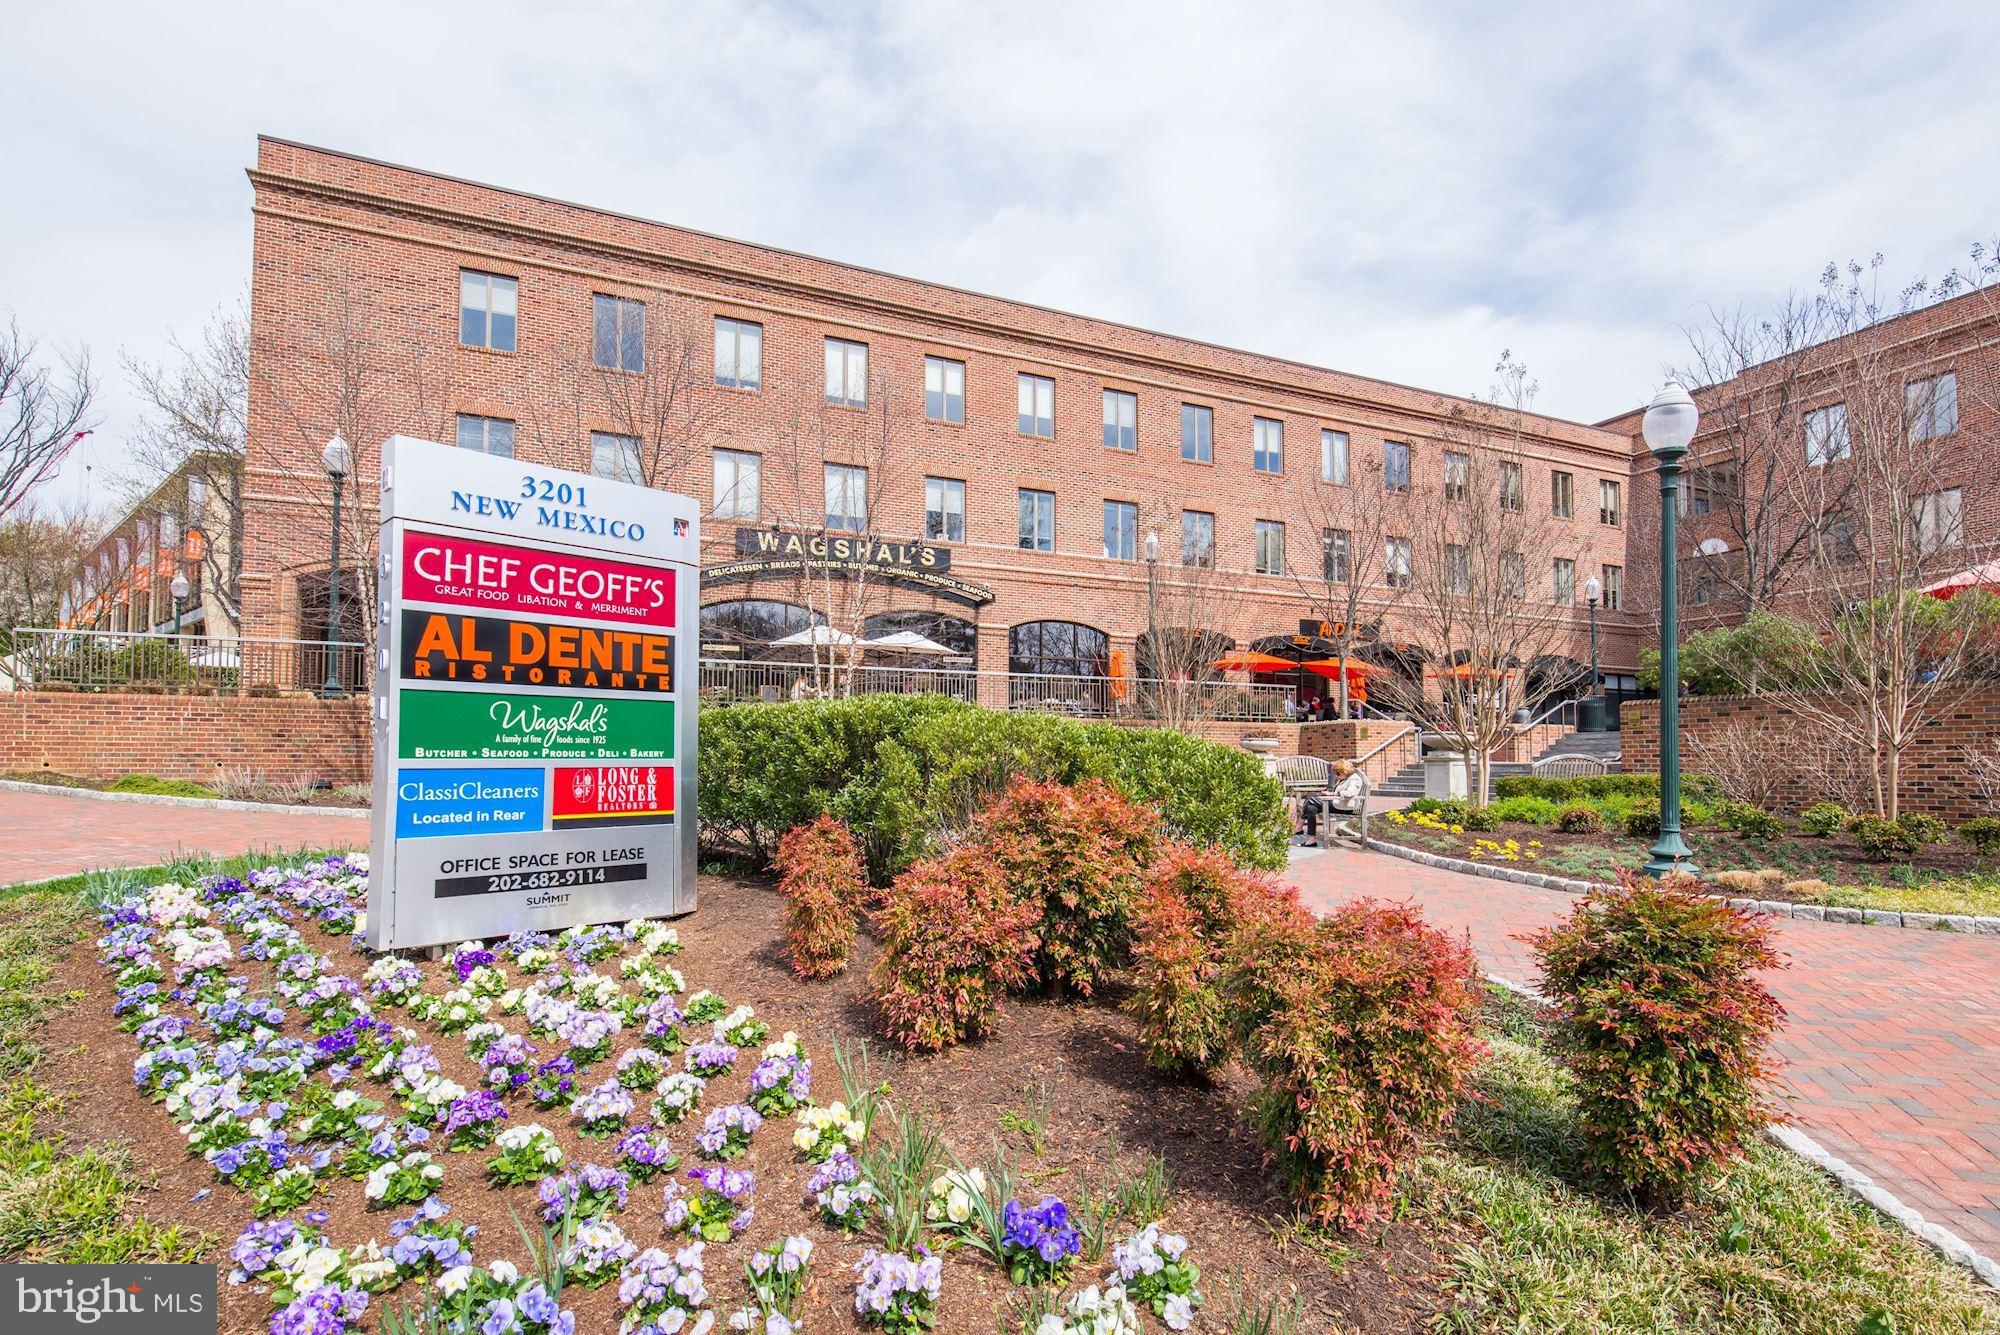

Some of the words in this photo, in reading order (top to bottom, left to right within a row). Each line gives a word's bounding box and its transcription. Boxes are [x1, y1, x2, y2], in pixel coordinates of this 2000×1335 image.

[521, 475, 587, 507] 3201
[452, 490, 522, 521] NEW
[537, 506, 645, 542] MEXICO
[757, 531, 936, 566] WAGSHAL'S
[413, 547, 521, 588] CHEF
[530, 563, 665, 608] GEOFF'S
[708, 563, 763, 577] DELICATESSEN
[770, 560, 801, 569] BREADS
[807, 560, 842, 568] PASTRIES
[886, 567, 919, 578] ORGANIC
[924, 574, 956, 588] PRODUCE
[961, 583, 993, 600] SEAFOOD
[435, 584, 474, 597] GREAT
[477, 588, 510, 601] FOOD
[517, 593, 567, 608] LIBATION
[575, 601, 583, 610] &
[591, 602, 648, 617] MERRIMENT
[415, 615, 492, 662] AL
[510, 622, 670, 675] DENTE
[415, 659, 670, 690] RISTORANTE
[490, 700, 608, 748] Wagshal's
[415, 747, 468, 758] BUTCHER
[481, 748, 529, 758] SEAFOOD
[541, 748, 586, 758] PRODUCE
[598, 748, 619, 758] DELI
[630, 748, 664, 758] BAKERY
[495, 735, 501, 743] A
[502, 734, 521, 745] family
[522, 734, 530, 743] of
[530, 734, 542, 743] fine
[556, 735, 573, 743] foods
[575, 735, 590, 743] since
[592, 735, 606, 744] 1925
[598, 768, 639, 785] LONG
[647, 768, 657, 785] &
[400, 780, 539, 802] ClassiCleaners
[598, 784, 657, 803] FOSTER
[412, 810, 474, 825] Located
[476, 810, 489, 823] in
[493, 809, 525, 822] Rear
[598, 802, 644, 811] REALTORS
[440, 856, 501, 874] OFFICE
[508, 852, 559, 870] SPACE
[566, 850, 596, 866] FOR
[602, 847, 645, 862] LEASE
[488, 868, 605, 892] 202-682-9114
[526, 893, 571, 906] SUMMIT
